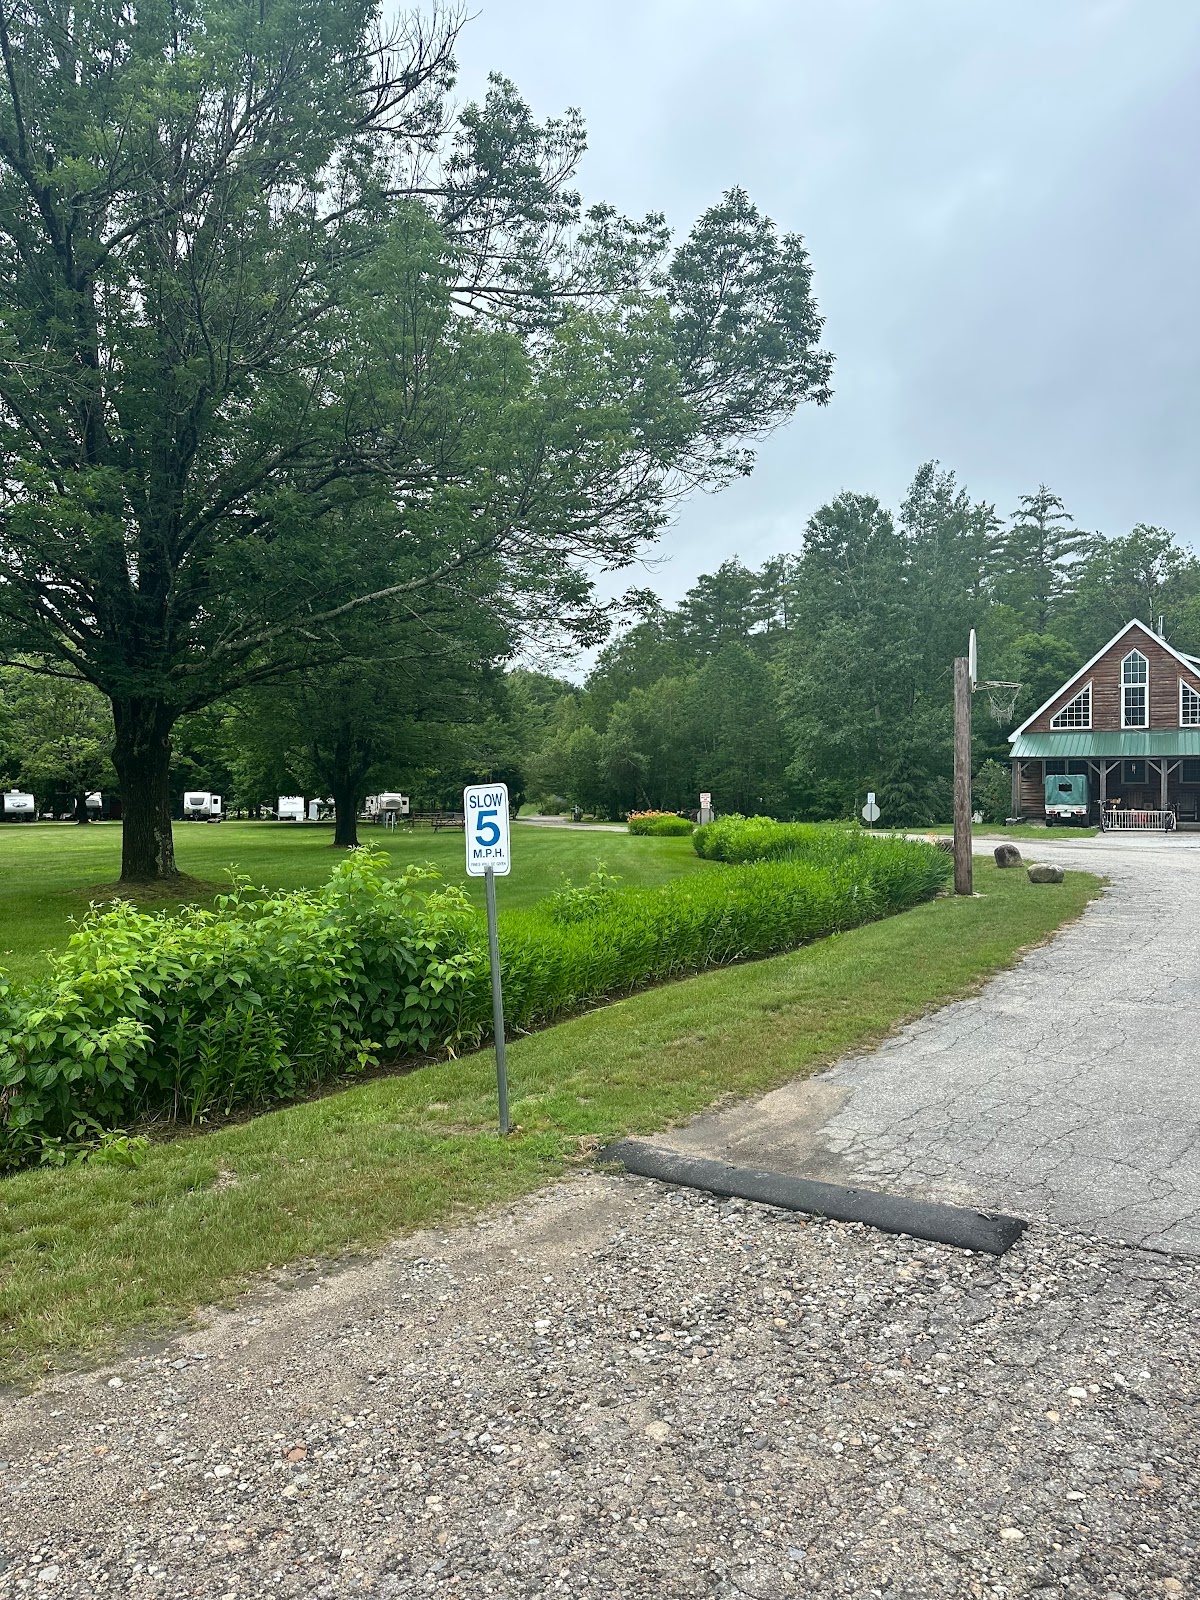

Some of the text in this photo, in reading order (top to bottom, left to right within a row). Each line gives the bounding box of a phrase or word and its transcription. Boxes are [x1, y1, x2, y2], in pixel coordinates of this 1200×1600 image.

[469, 793, 503, 808] SLOW
[475, 810, 500, 846] 5
[473, 848, 505, 858] M.P.H.
